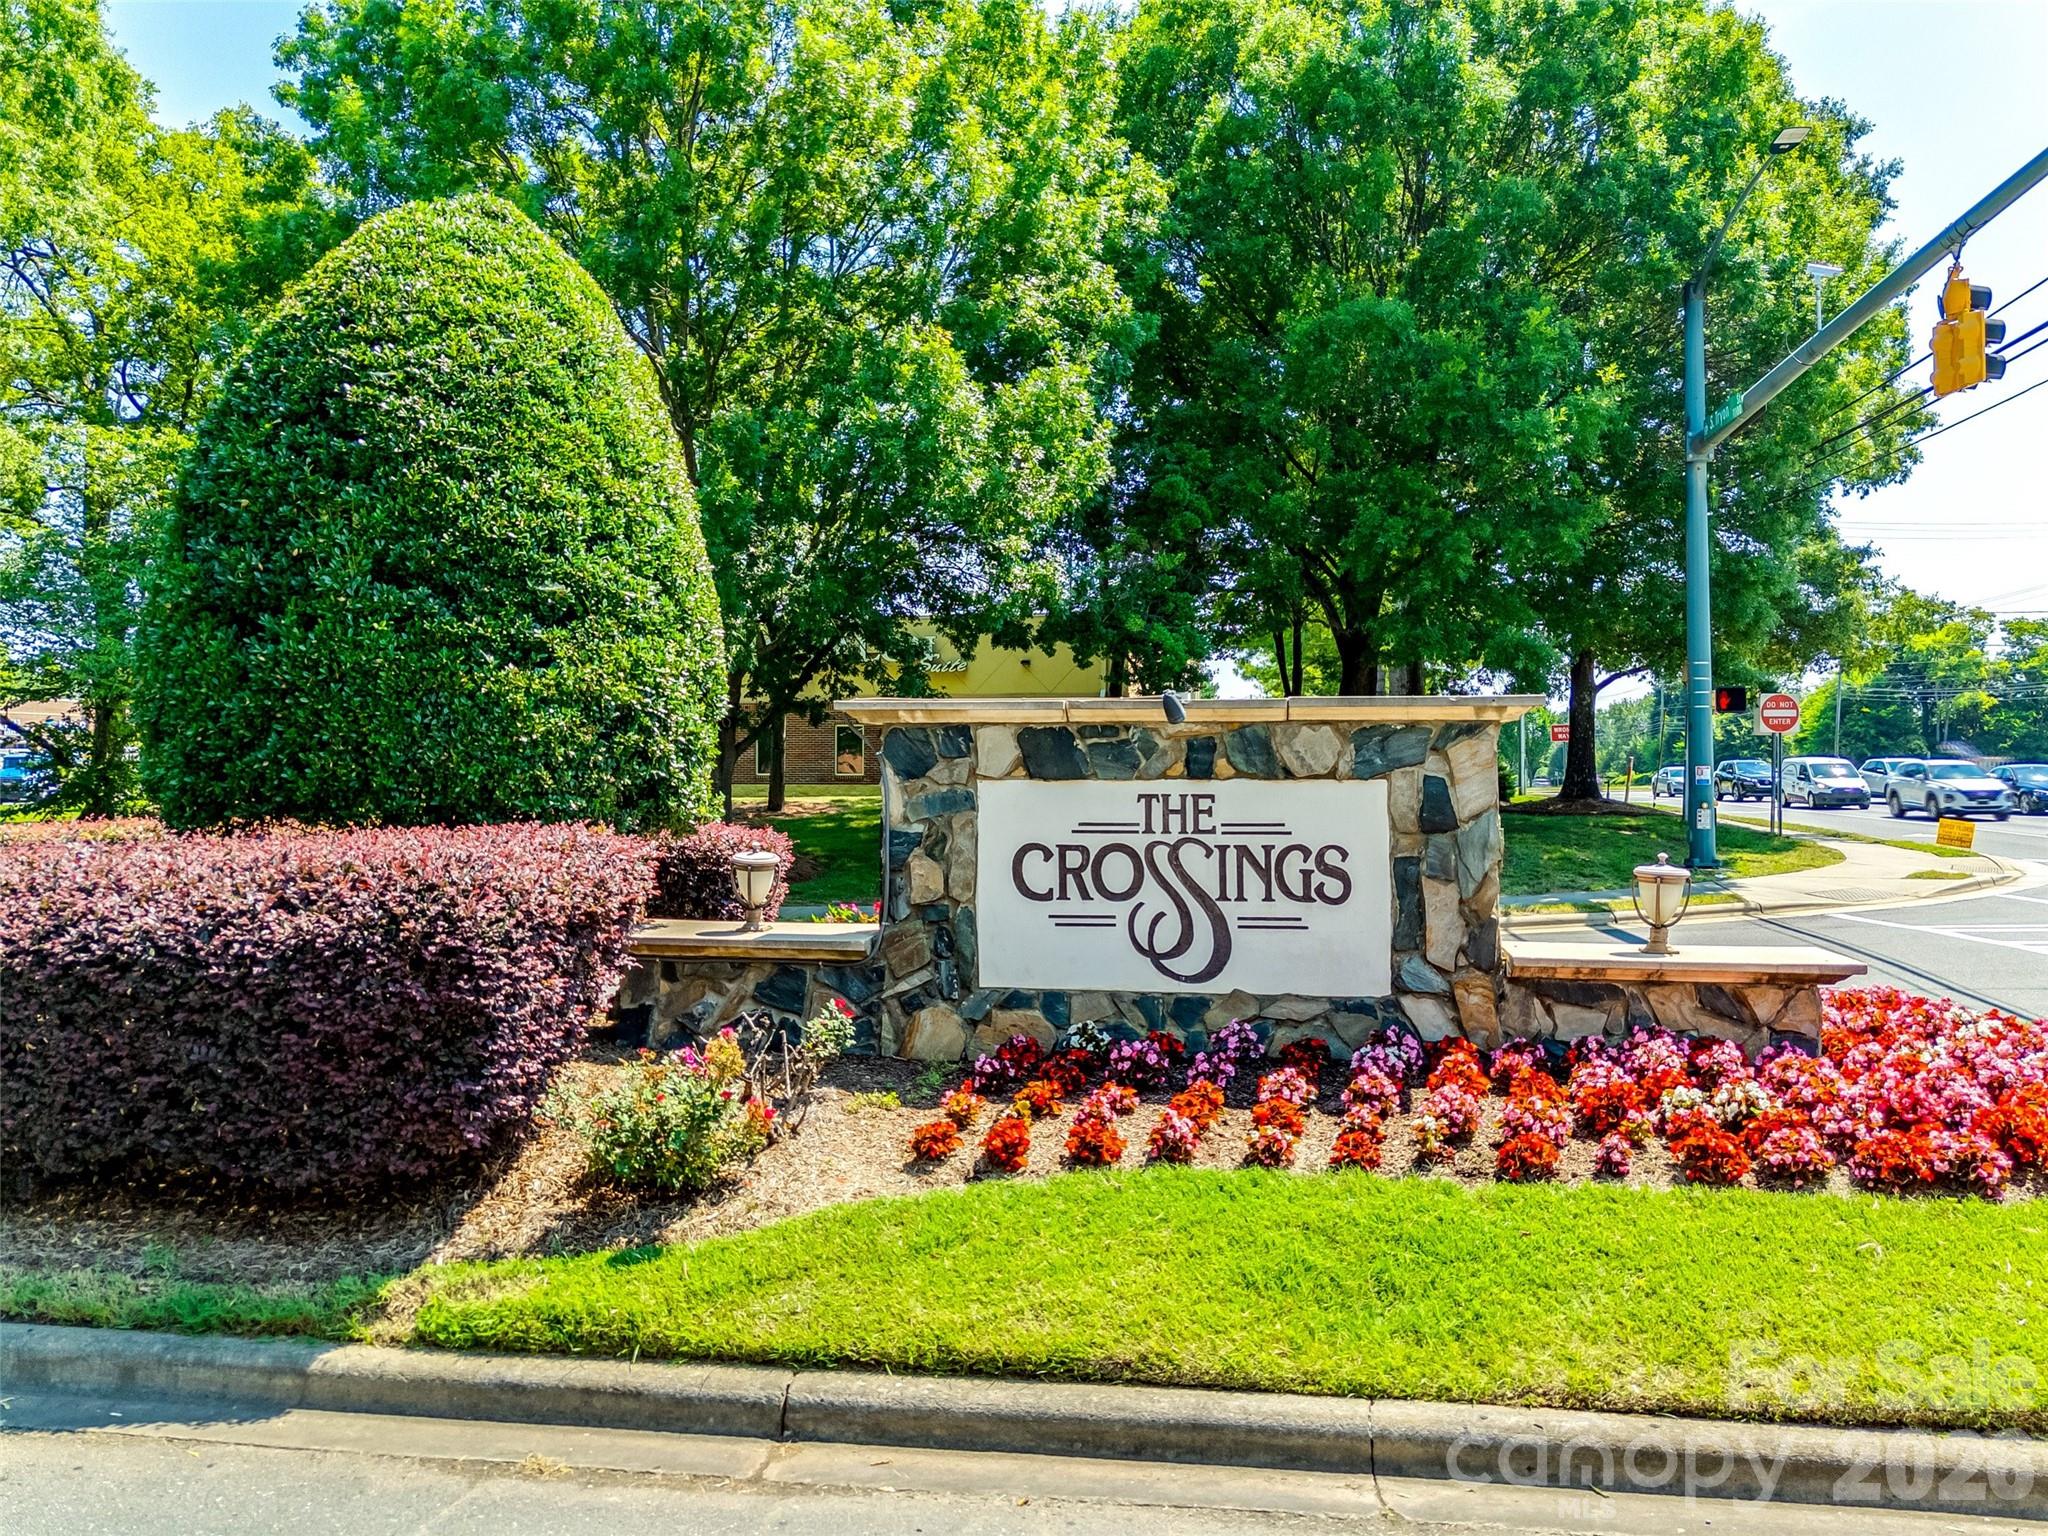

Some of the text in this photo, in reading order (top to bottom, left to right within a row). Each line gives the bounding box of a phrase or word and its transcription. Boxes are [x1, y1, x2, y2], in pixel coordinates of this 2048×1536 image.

[919, 653, 967, 673] Suite
[1137, 793, 1217, 835] THE
[1011, 837, 1353, 984] CROSSINGS
